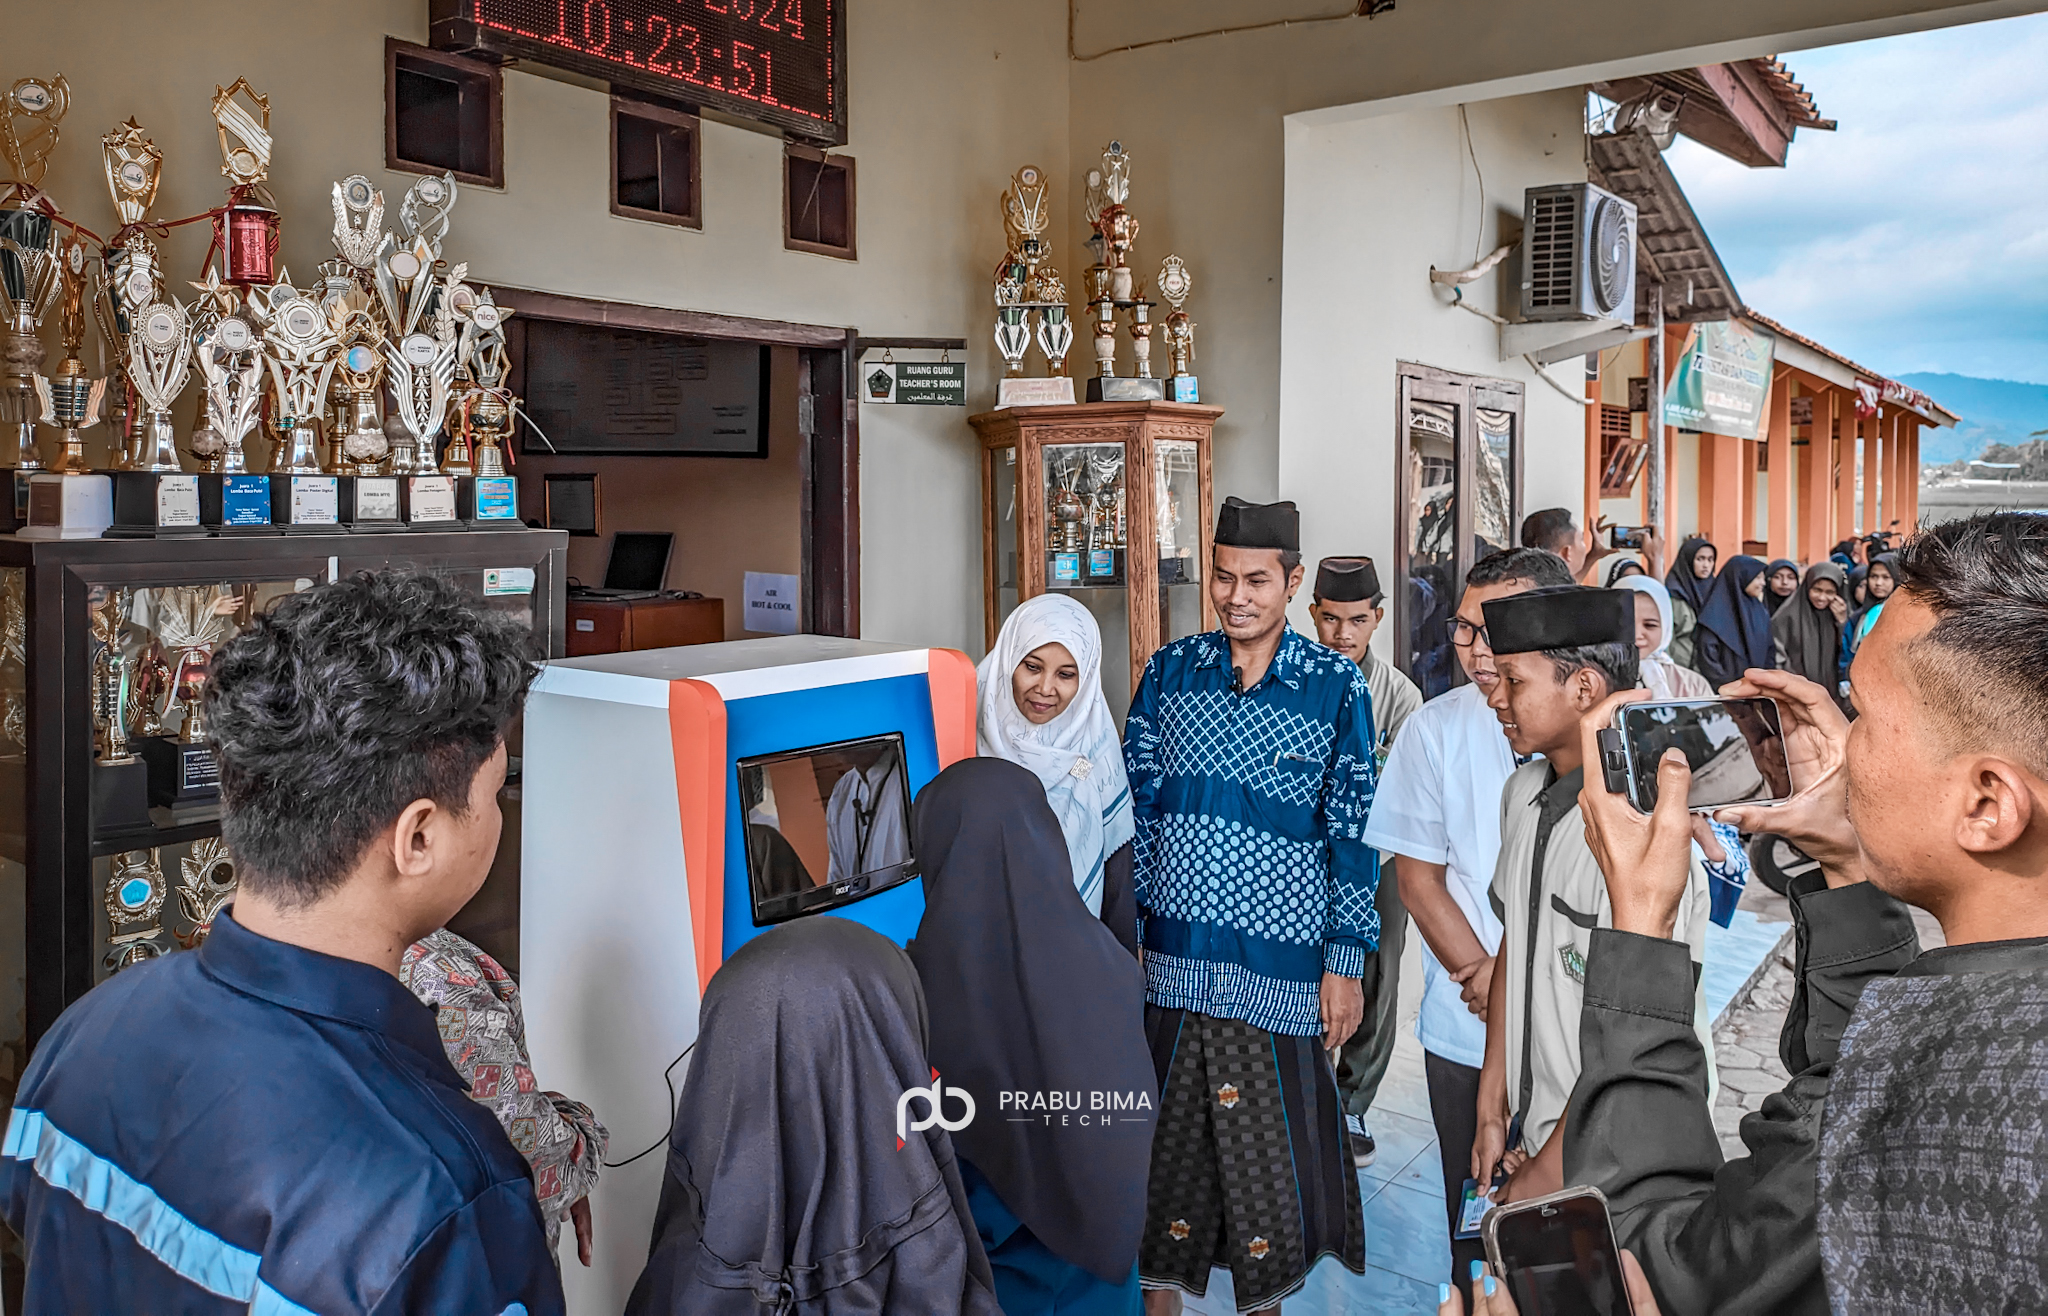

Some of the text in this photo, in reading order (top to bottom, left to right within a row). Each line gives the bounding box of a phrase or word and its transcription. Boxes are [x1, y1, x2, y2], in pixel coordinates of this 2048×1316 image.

[551, 0, 778, 101] 10:23:51
[477, 311, 496, 321] nice
[907, 366, 954, 375] RUANG GURU
[899, 379, 961, 388] TEACHER'S ROOM
[765, 589, 777, 597] AIR
[751, 600, 765, 608] HOT
[773, 602, 792, 611] COOL
[835, 884, 850, 895] acer
